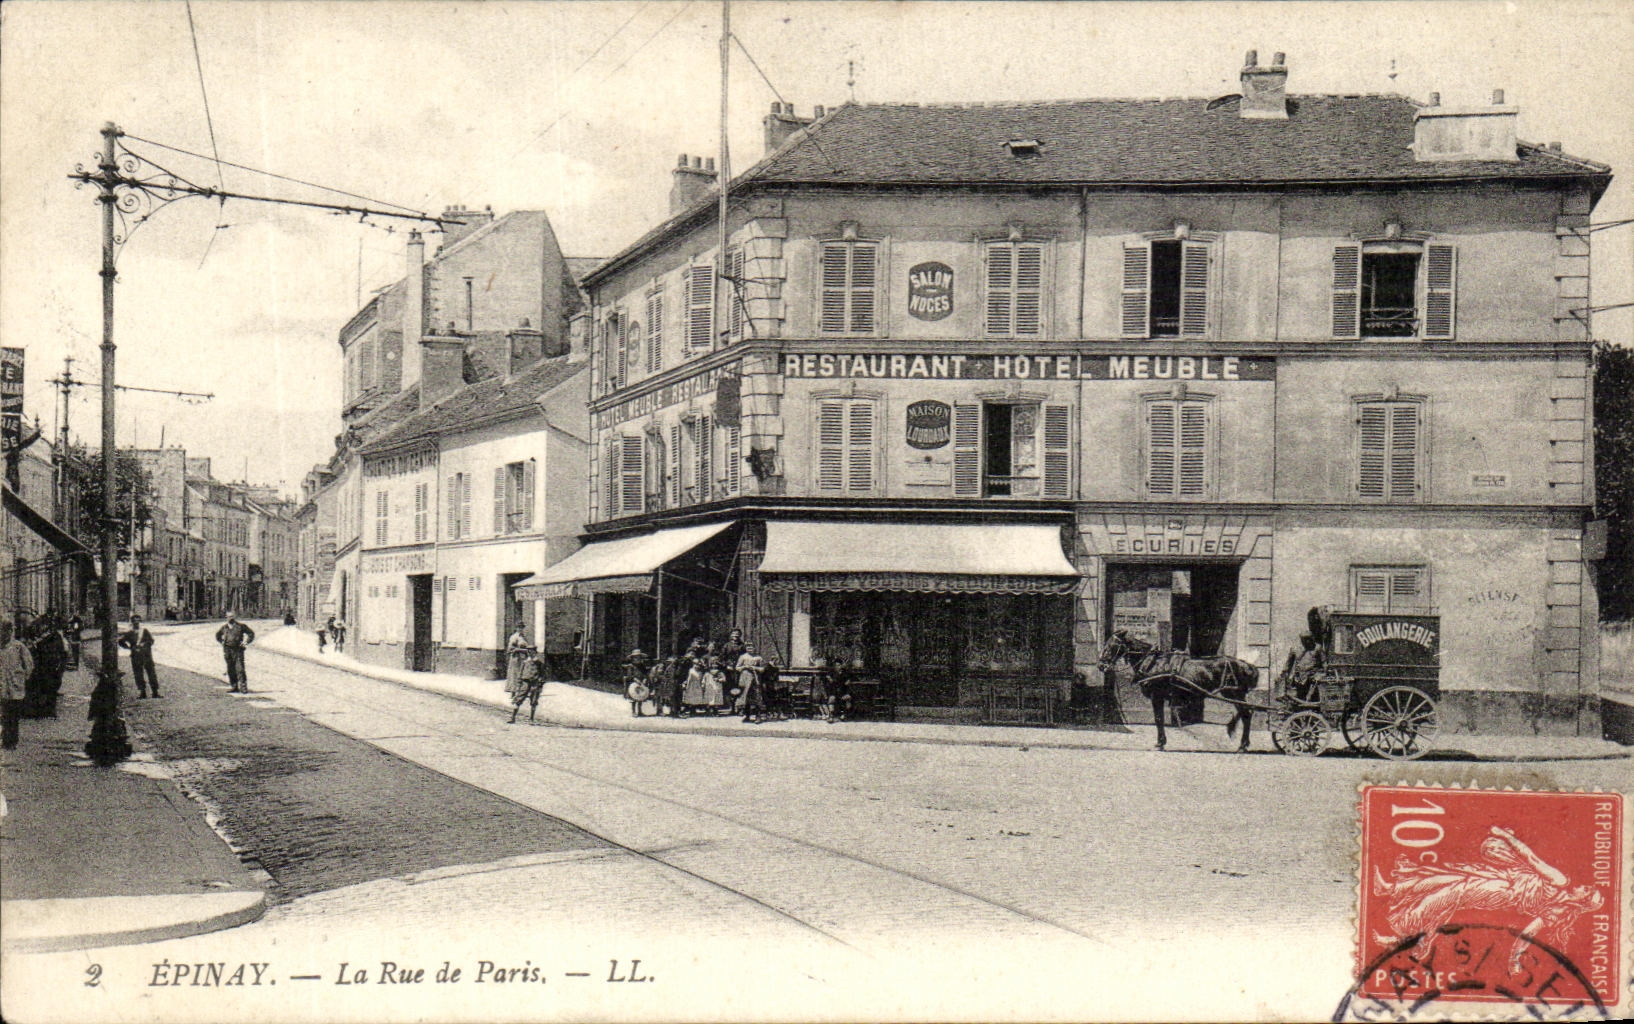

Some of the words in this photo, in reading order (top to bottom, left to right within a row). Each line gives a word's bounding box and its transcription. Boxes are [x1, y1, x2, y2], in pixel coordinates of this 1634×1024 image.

[910, 270, 952, 289] SALON
[909, 294, 950, 313] NOCES
[785, 354, 966, 378] RESTAURANT
[1109, 355, 1240, 379] MEUBLE
[908, 405, 951, 418] MAISON
[1116, 539, 1234, 553] ECURIES
[1356, 622, 1436, 648] BOULANGERIE
[1593, 801, 1612, 887] REPUBLIQUE
[1375, 969, 1458, 990] POSTES
